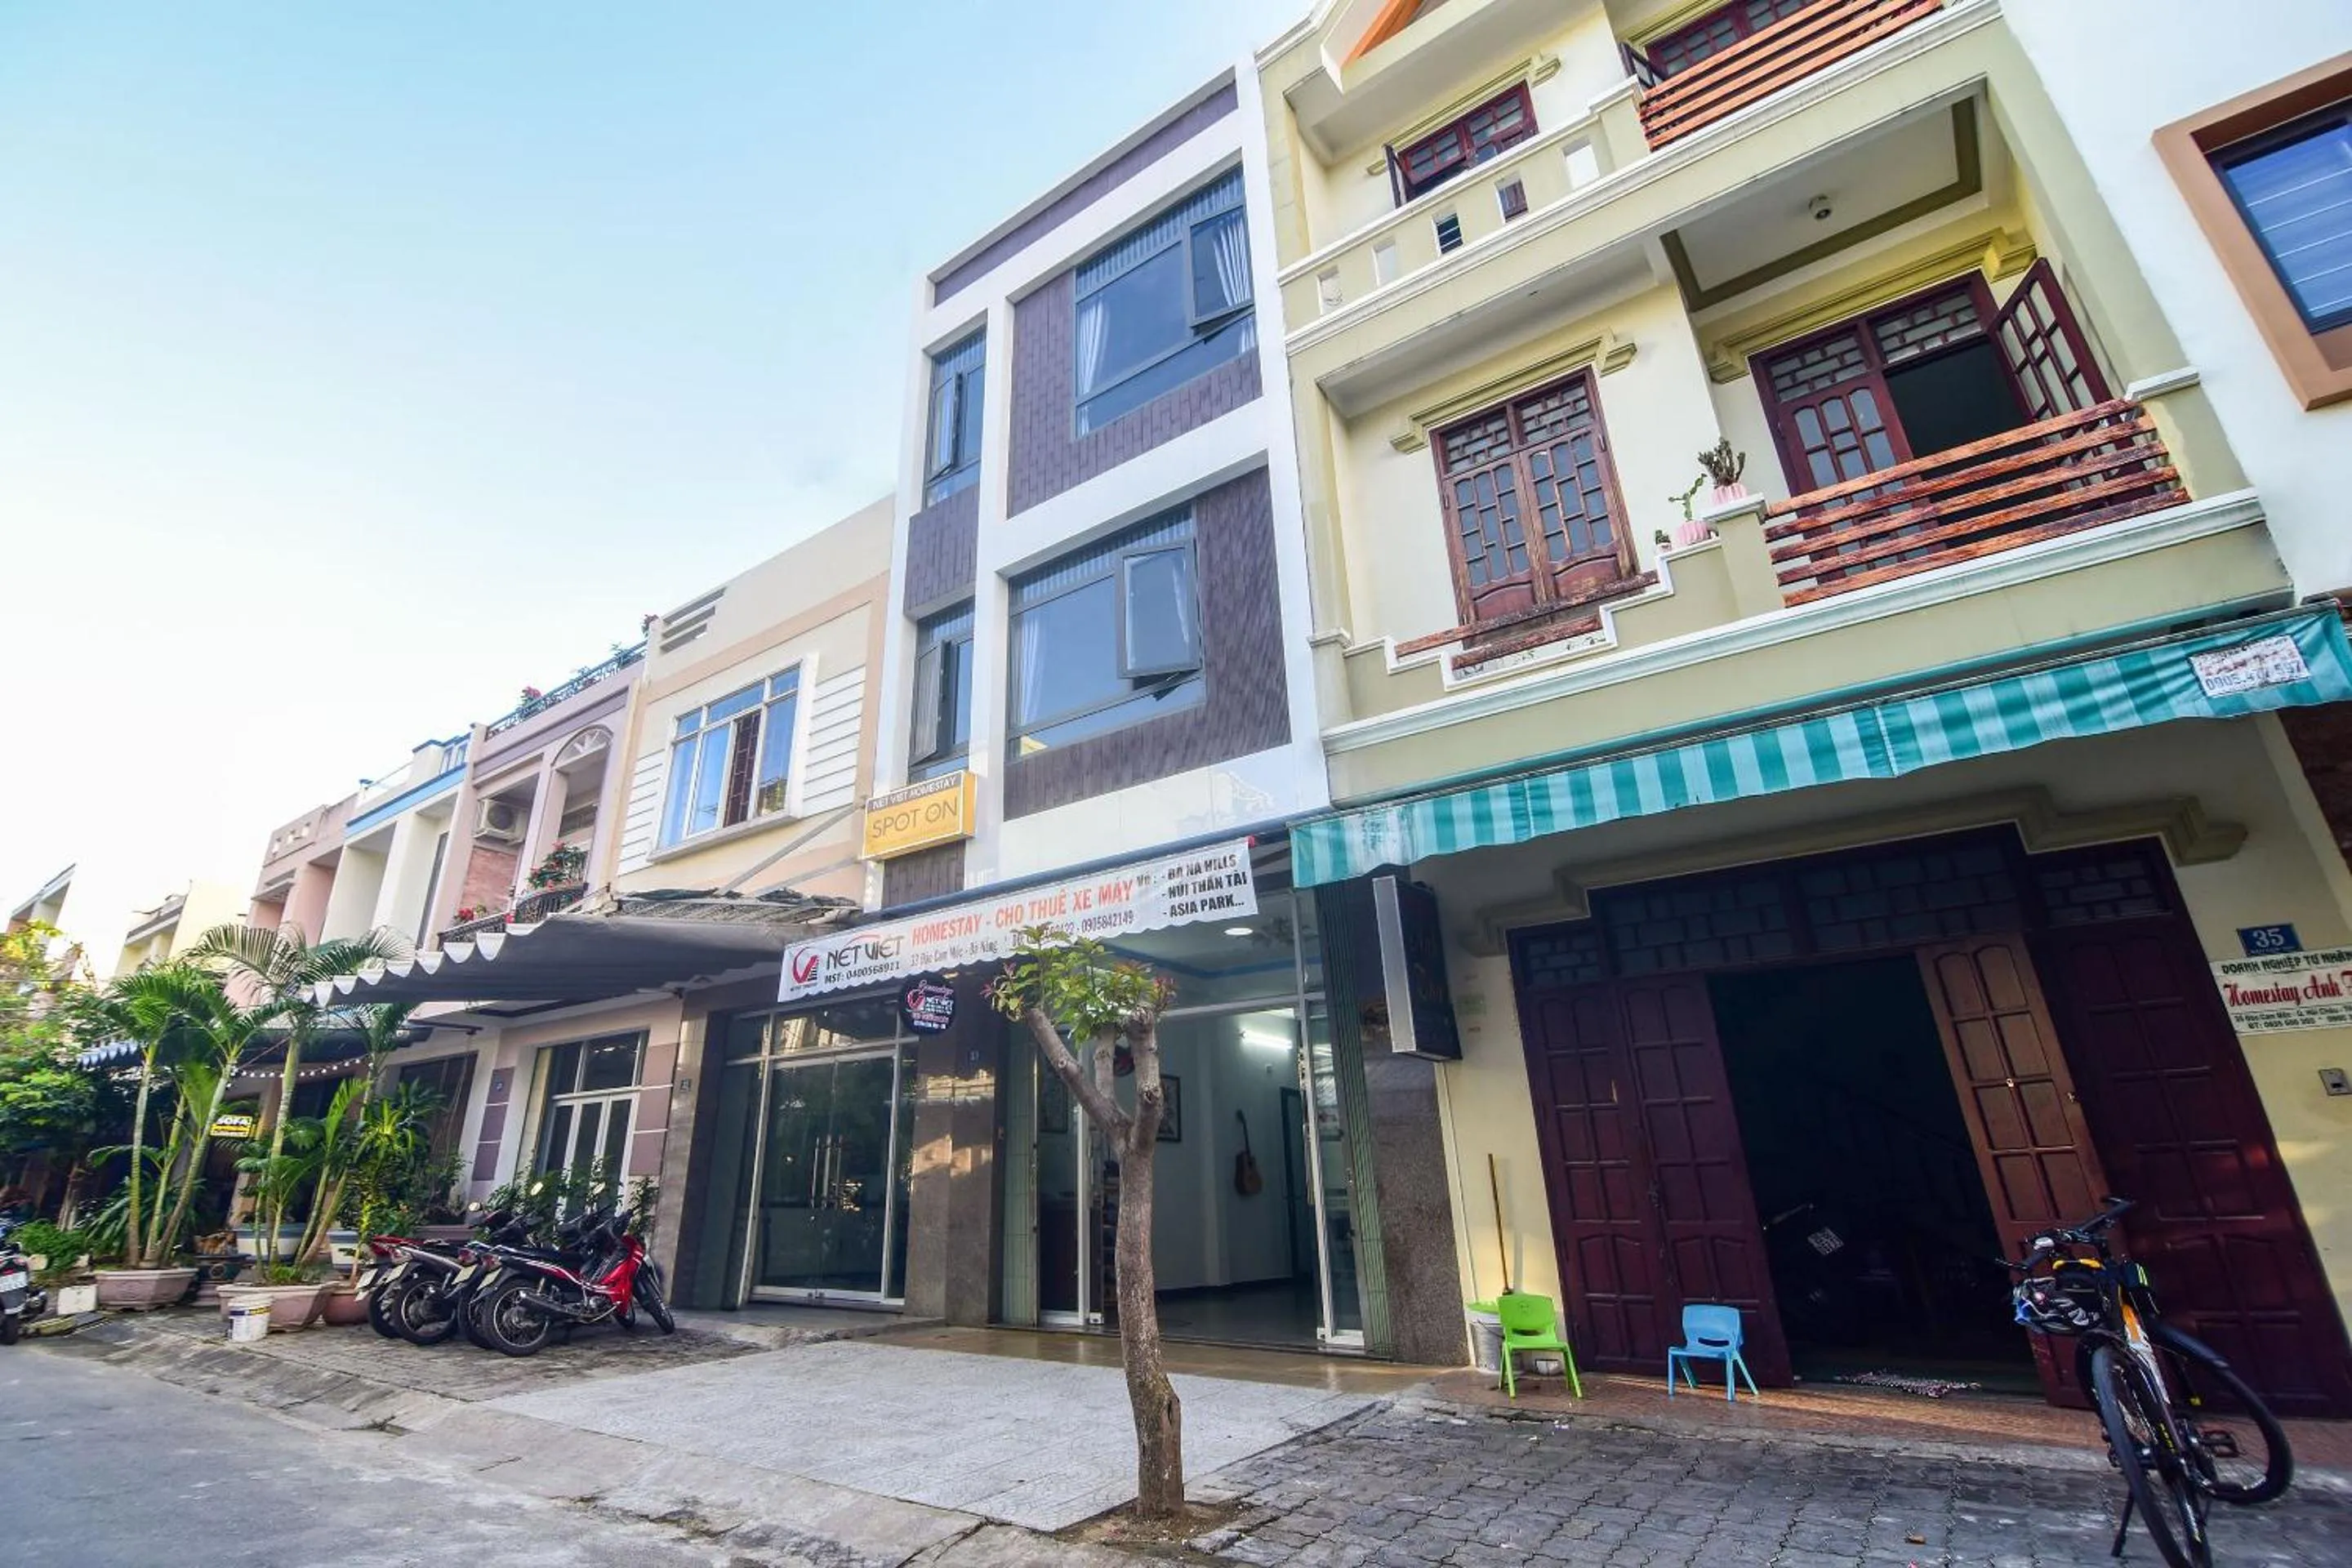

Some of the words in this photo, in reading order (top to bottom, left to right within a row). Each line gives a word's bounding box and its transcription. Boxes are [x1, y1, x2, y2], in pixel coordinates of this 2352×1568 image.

[872, 808, 921, 839] SPOT
[924, 795, 958, 822] ON
[912, 915, 982, 945] HOMESTAY
[995, 906, 1024, 929] CHO
[1027, 891, 1067, 921] THUÊ
[1072, 889, 1092, 912] XE
[1169, 900, 1199, 917] ASIA
[2252, 928, 2285, 948] 35
[826, 945, 862, 970] NET
[2223, 982, 2301, 1007] Homestay
